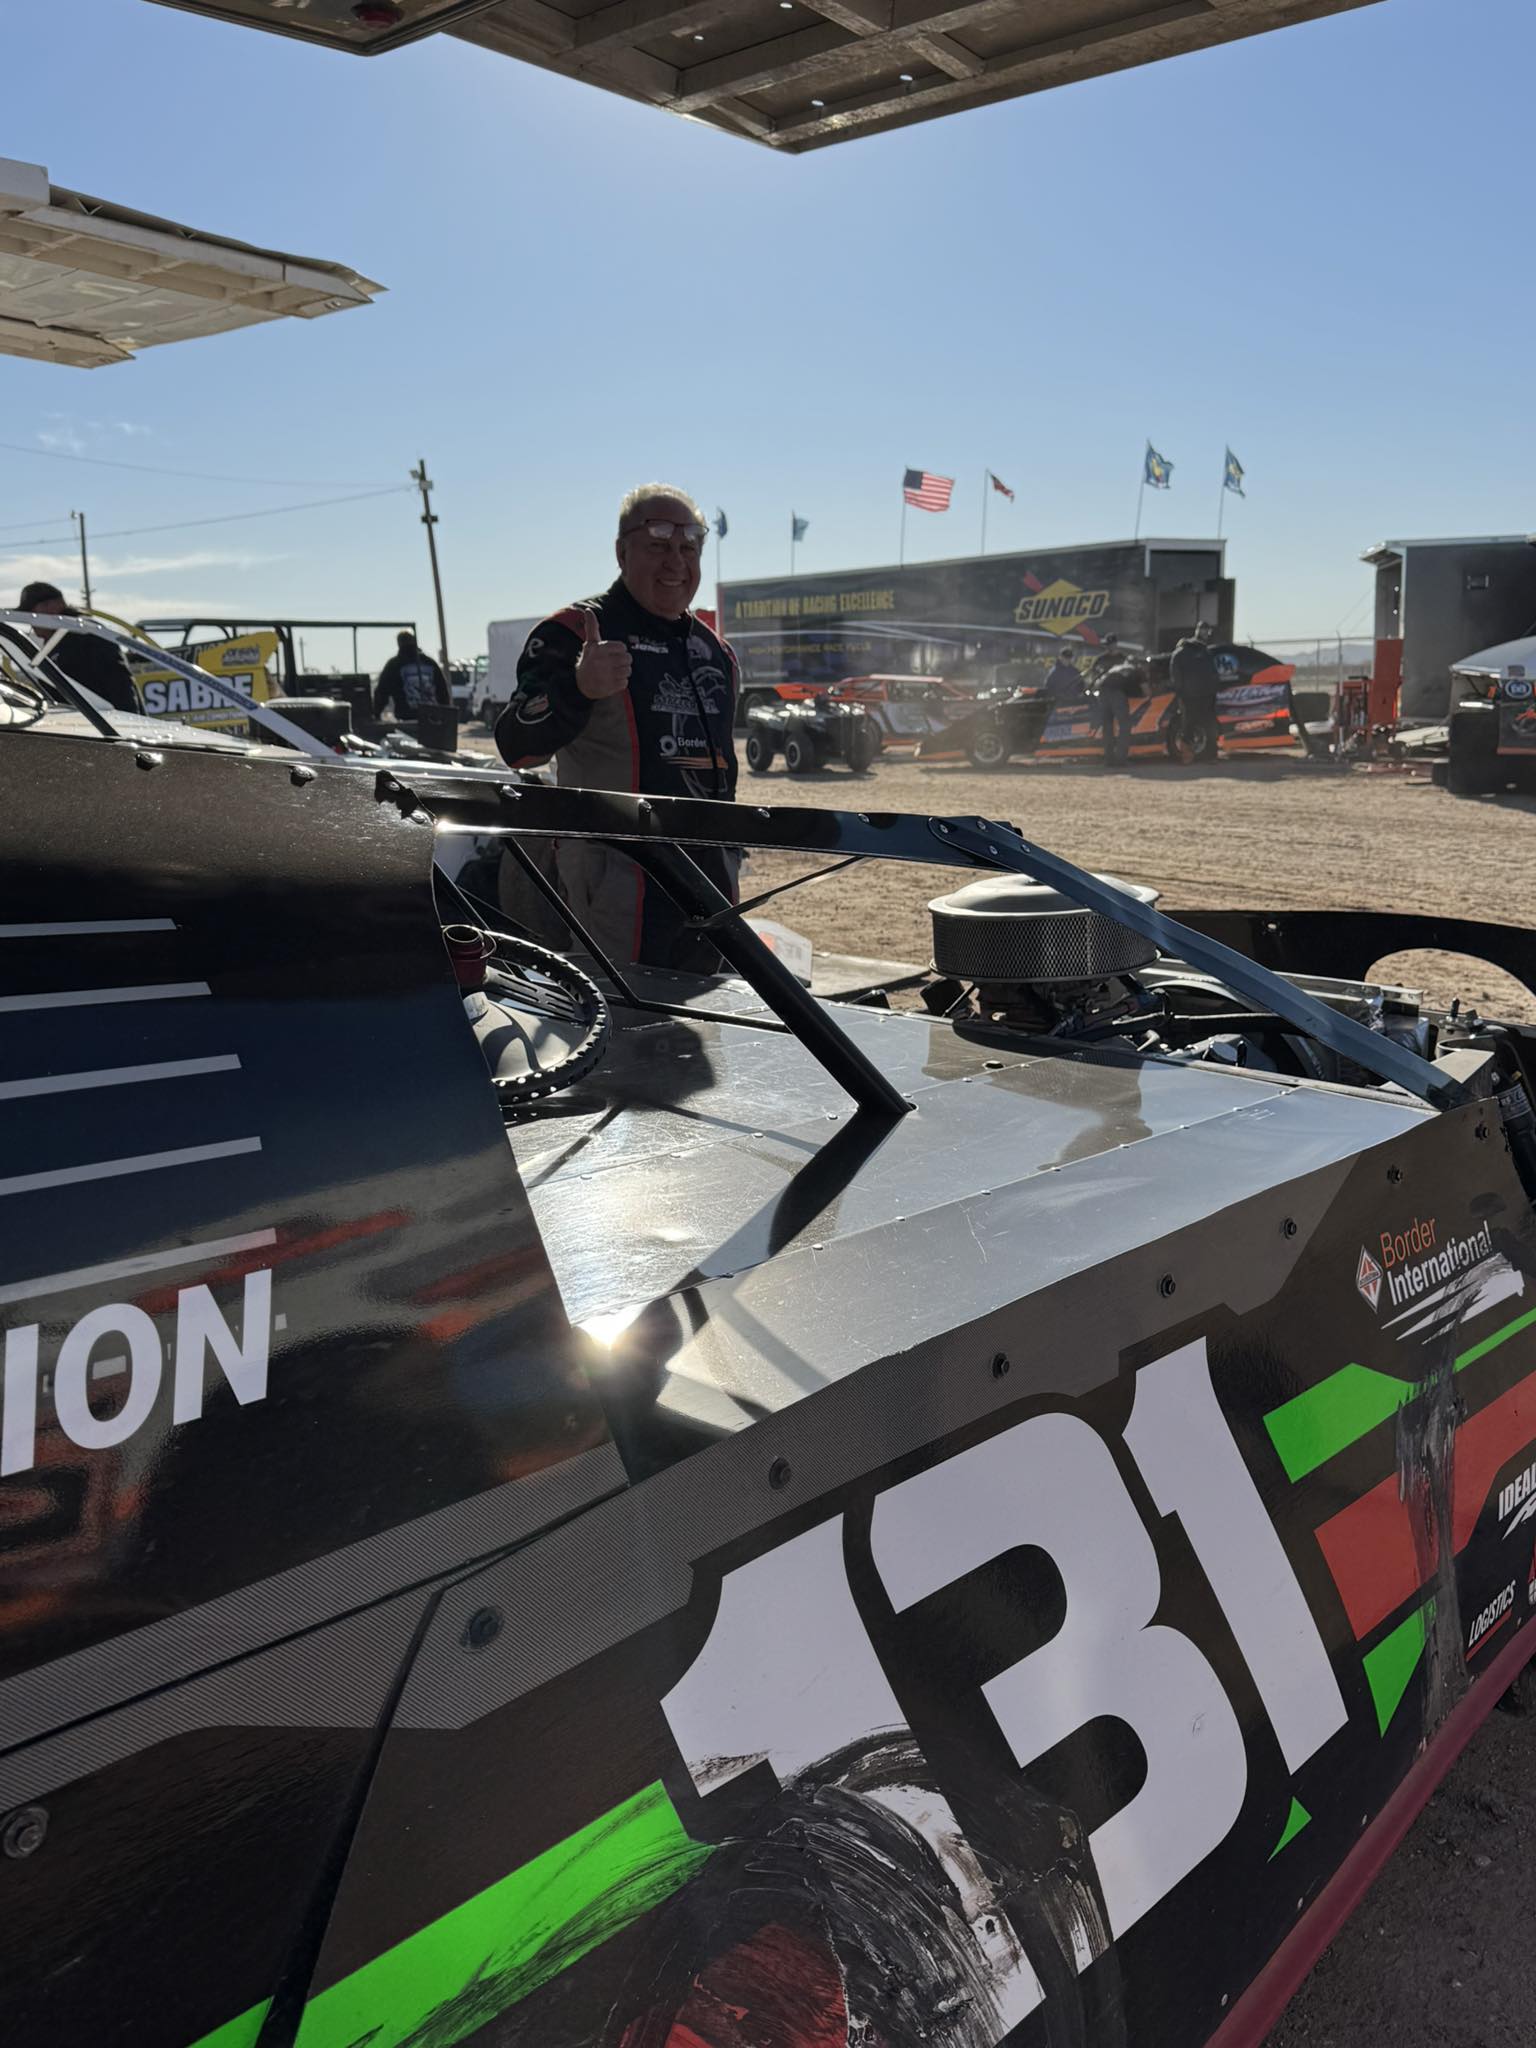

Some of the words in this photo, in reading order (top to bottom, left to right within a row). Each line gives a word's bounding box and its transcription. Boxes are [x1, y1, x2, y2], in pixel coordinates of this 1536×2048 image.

[802, 594, 837, 614] RACING
[840, 590, 895, 612] EXCELLENCE
[1018, 592, 1107, 621] SUNOCO
[1380, 1217, 1436, 1268] Border
[1387, 1219, 1492, 1307] International
[1, 1268, 272, 1477] ION
[1468, 1579, 1516, 1648] LOGISTICS
